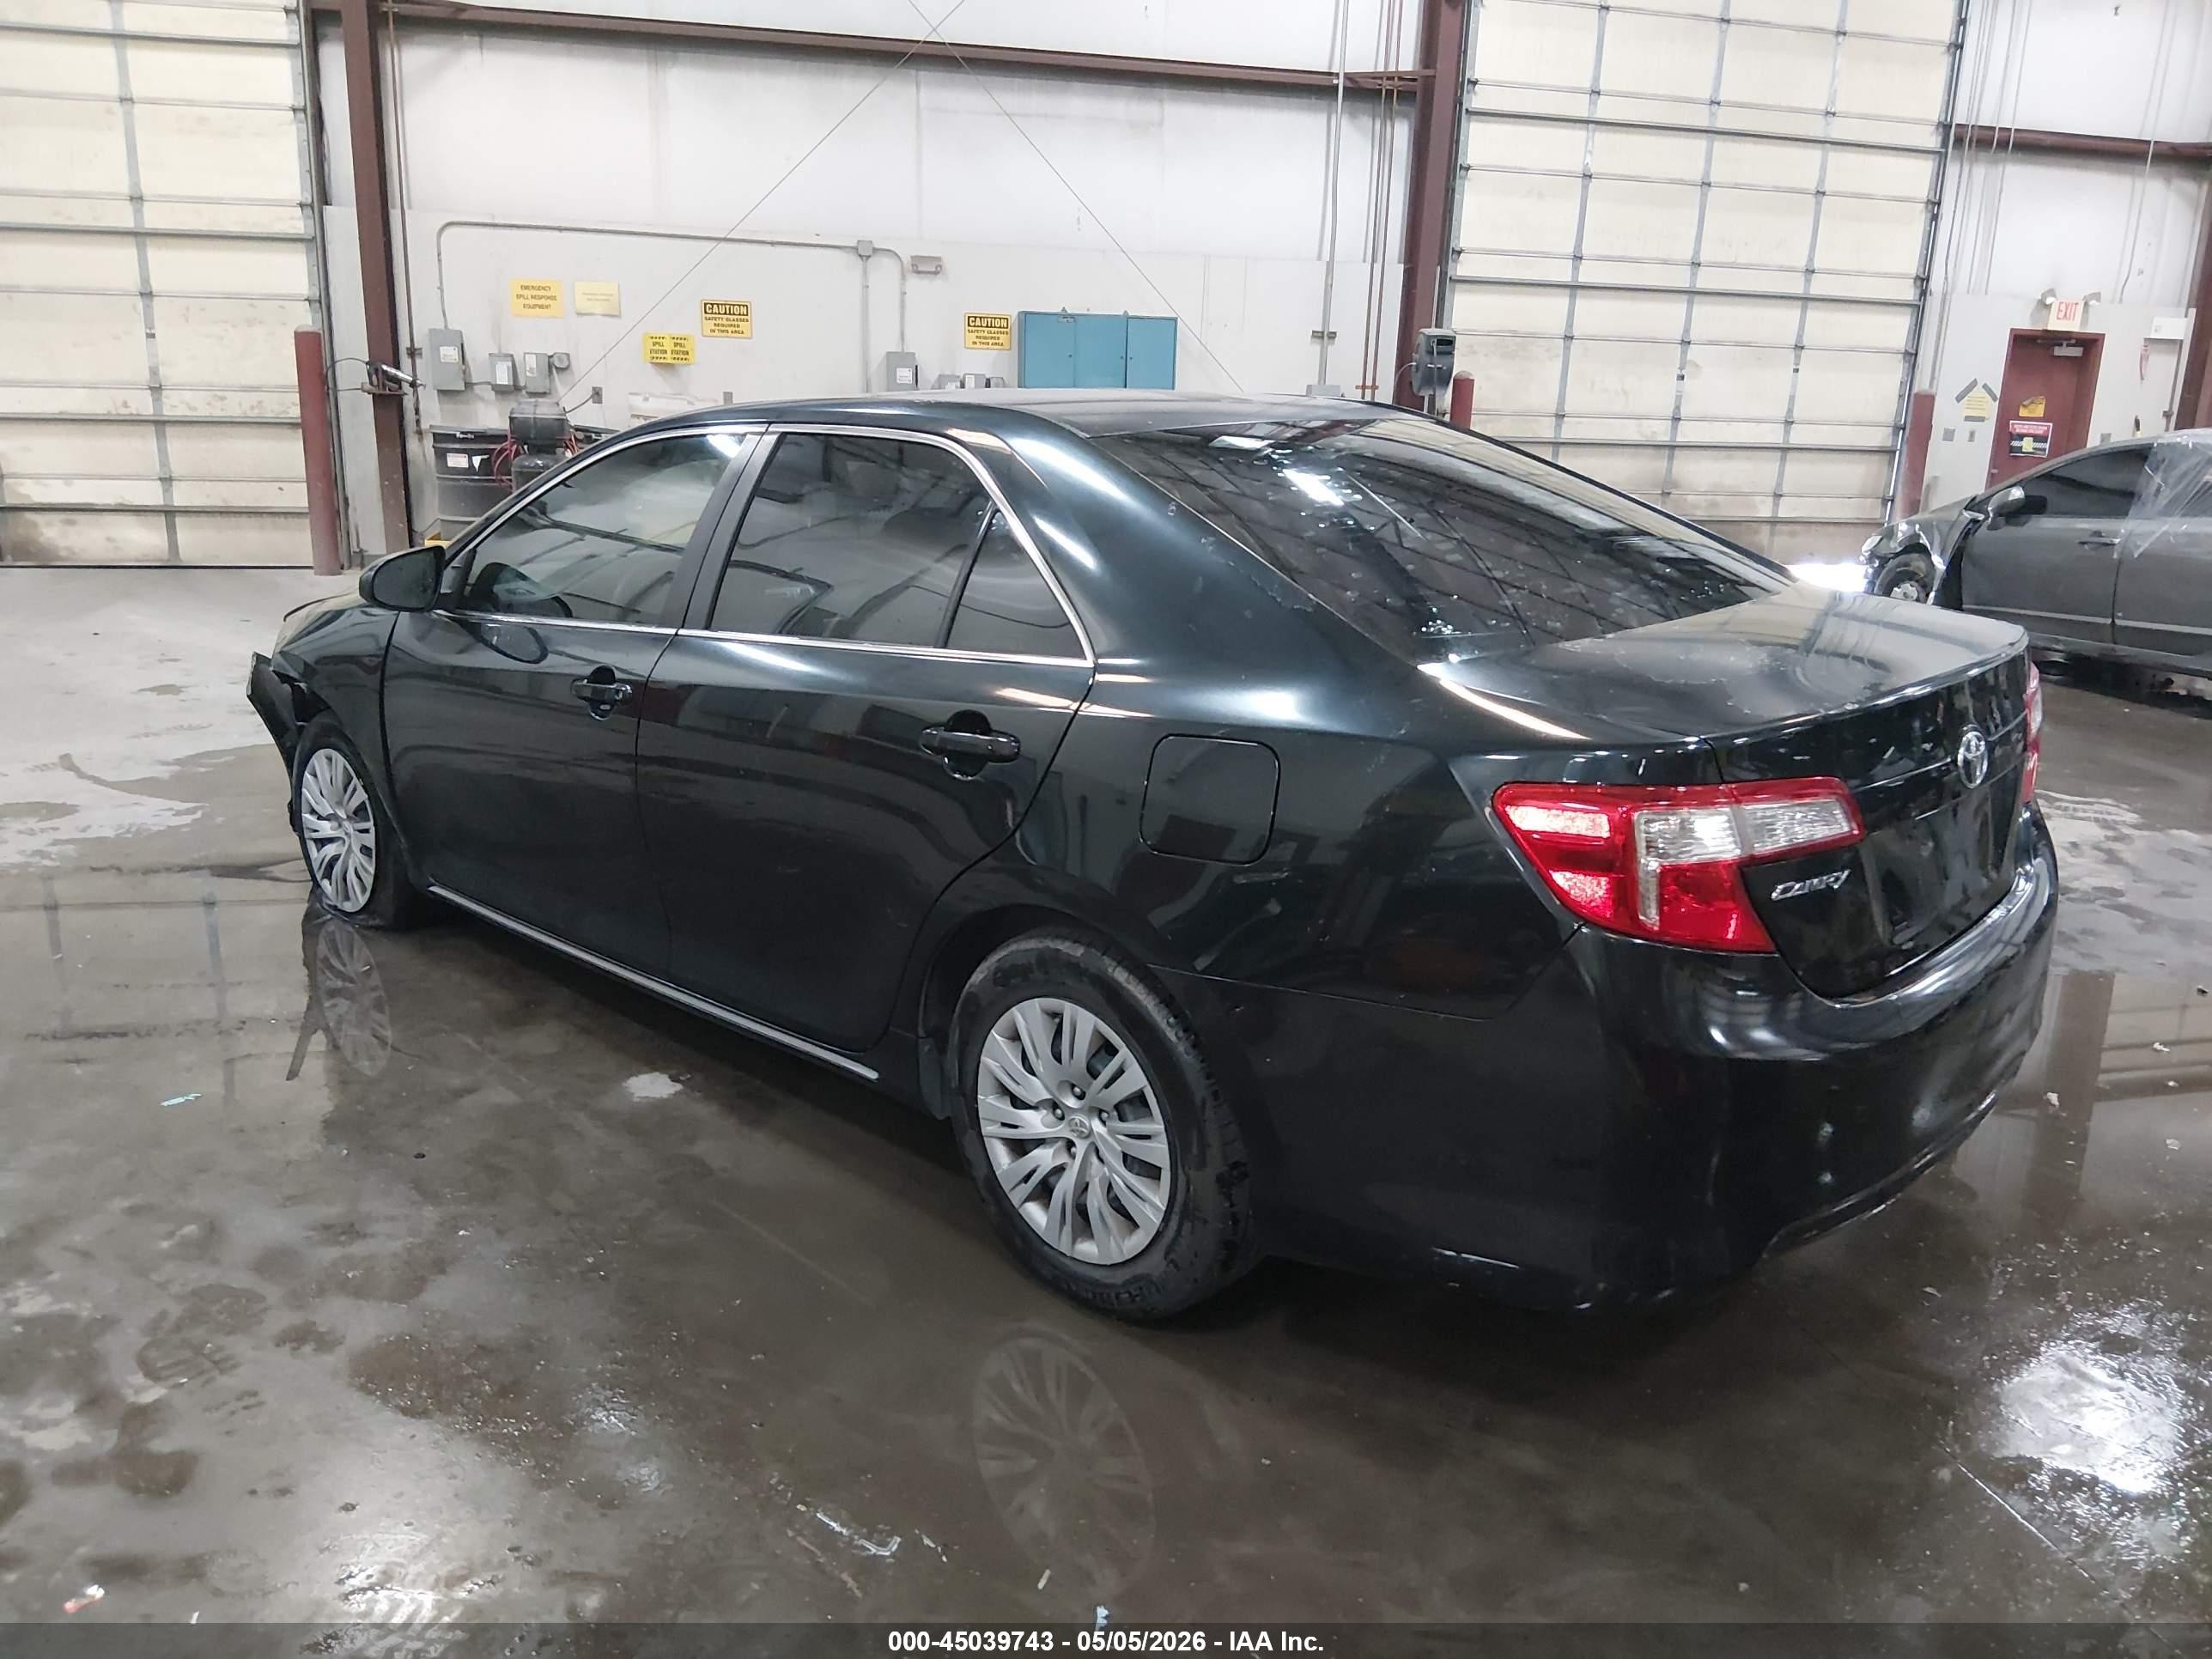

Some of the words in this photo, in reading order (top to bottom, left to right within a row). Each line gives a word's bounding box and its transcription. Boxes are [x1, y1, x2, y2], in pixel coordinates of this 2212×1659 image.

[705, 303, 747, 315] CAUTION
[2057, 301, 2079, 321] EXIT
[969, 317, 1007, 328] CAUTION
[1771, 869, 1850, 901] CAMRY
